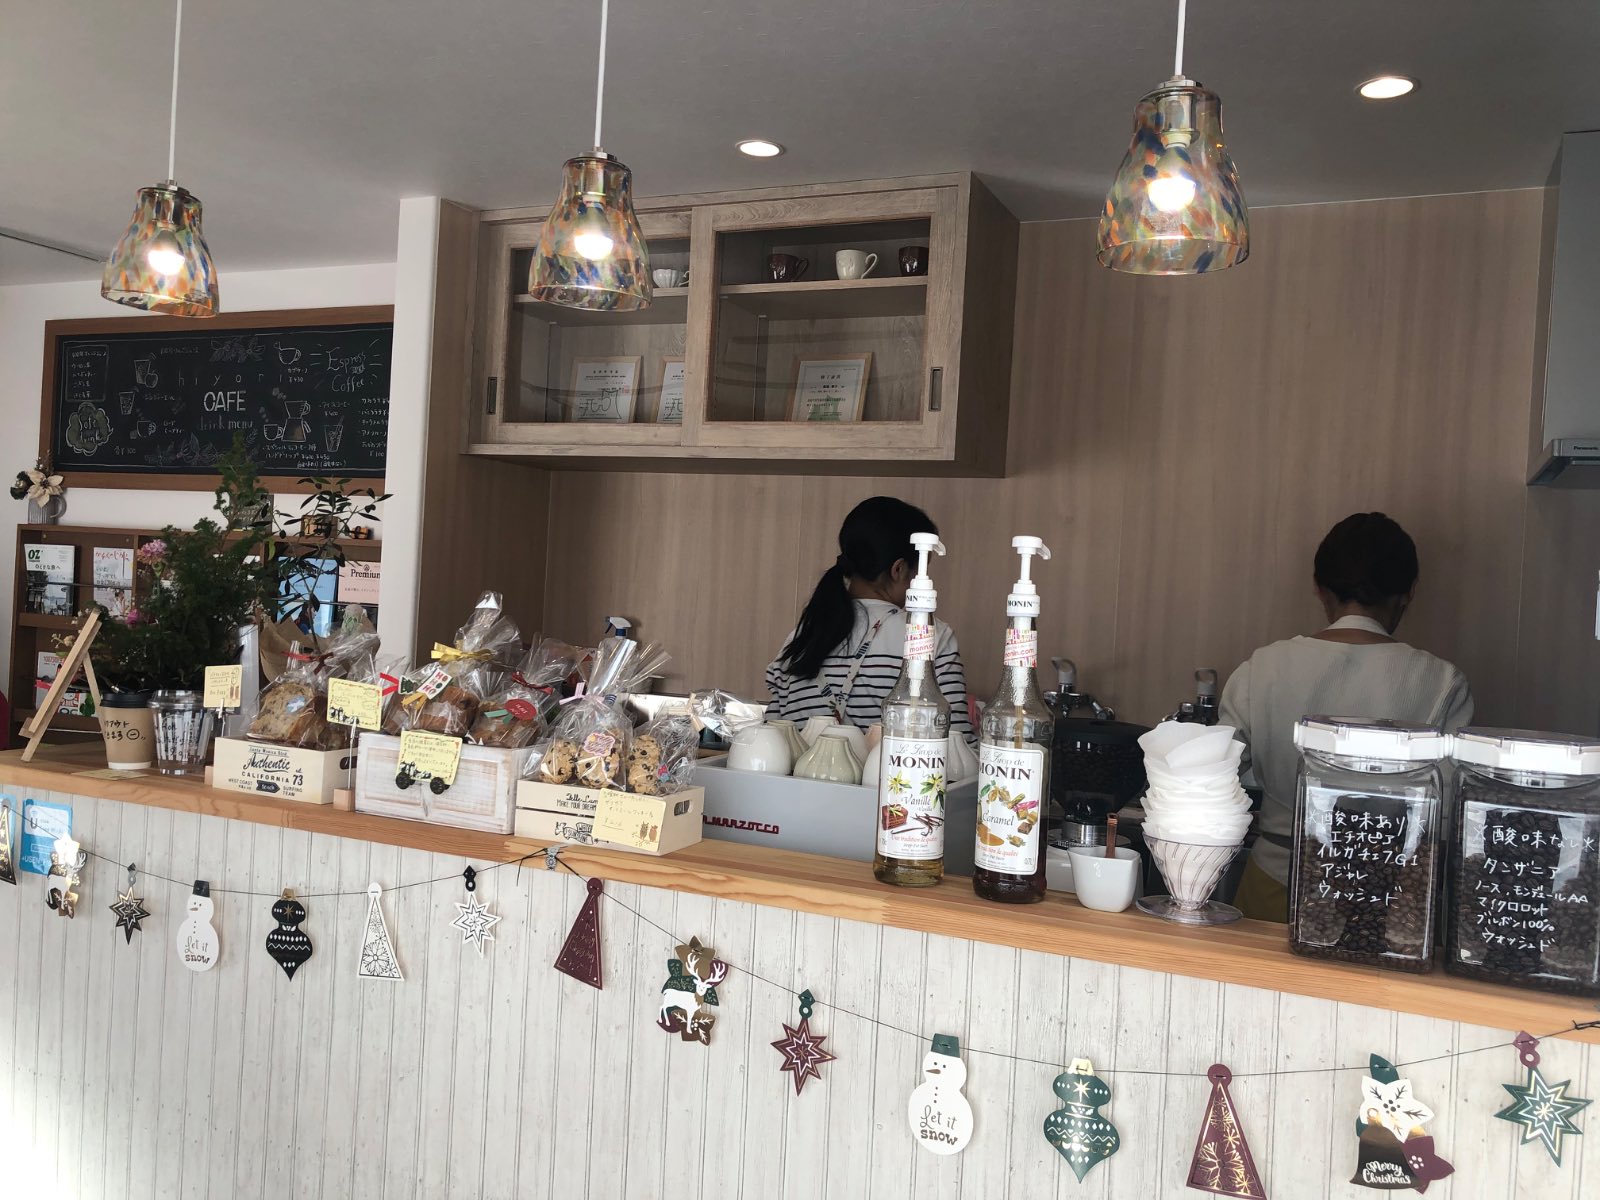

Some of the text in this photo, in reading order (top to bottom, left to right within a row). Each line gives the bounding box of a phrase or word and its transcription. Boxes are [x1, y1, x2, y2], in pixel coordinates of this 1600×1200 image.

[203, 390, 247, 412] CAFE
[28, 549, 41, 560] OZ
[435, 671, 449, 684] HO
[423, 684, 437, 696] HO
[242, 752, 291, 771] Authentic
[888, 755, 946, 769] MONIN
[241, 771, 290, 784] CALIFORNIA
[292, 774, 304, 786] 73
[1321, 809, 1406, 838] 酸味あり
[1331, 830, 1396, 846] エチオピア
[1492, 825, 1579, 849] 酸味なし
[1483, 857, 1561, 880] タンザニア
[1318, 879, 1404, 907] ウォッシュド
[1477, 896, 1549, 917] マイクロロット
[1482, 926, 1556, 953] ウォッシュド
[185, 954, 211, 965] snow
[919, 1105, 958, 1131] Let it
[920, 1129, 959, 1146] snow
[1362, 1168, 1412, 1185] Christmas
[1365, 1160, 1406, 1178] Merry
